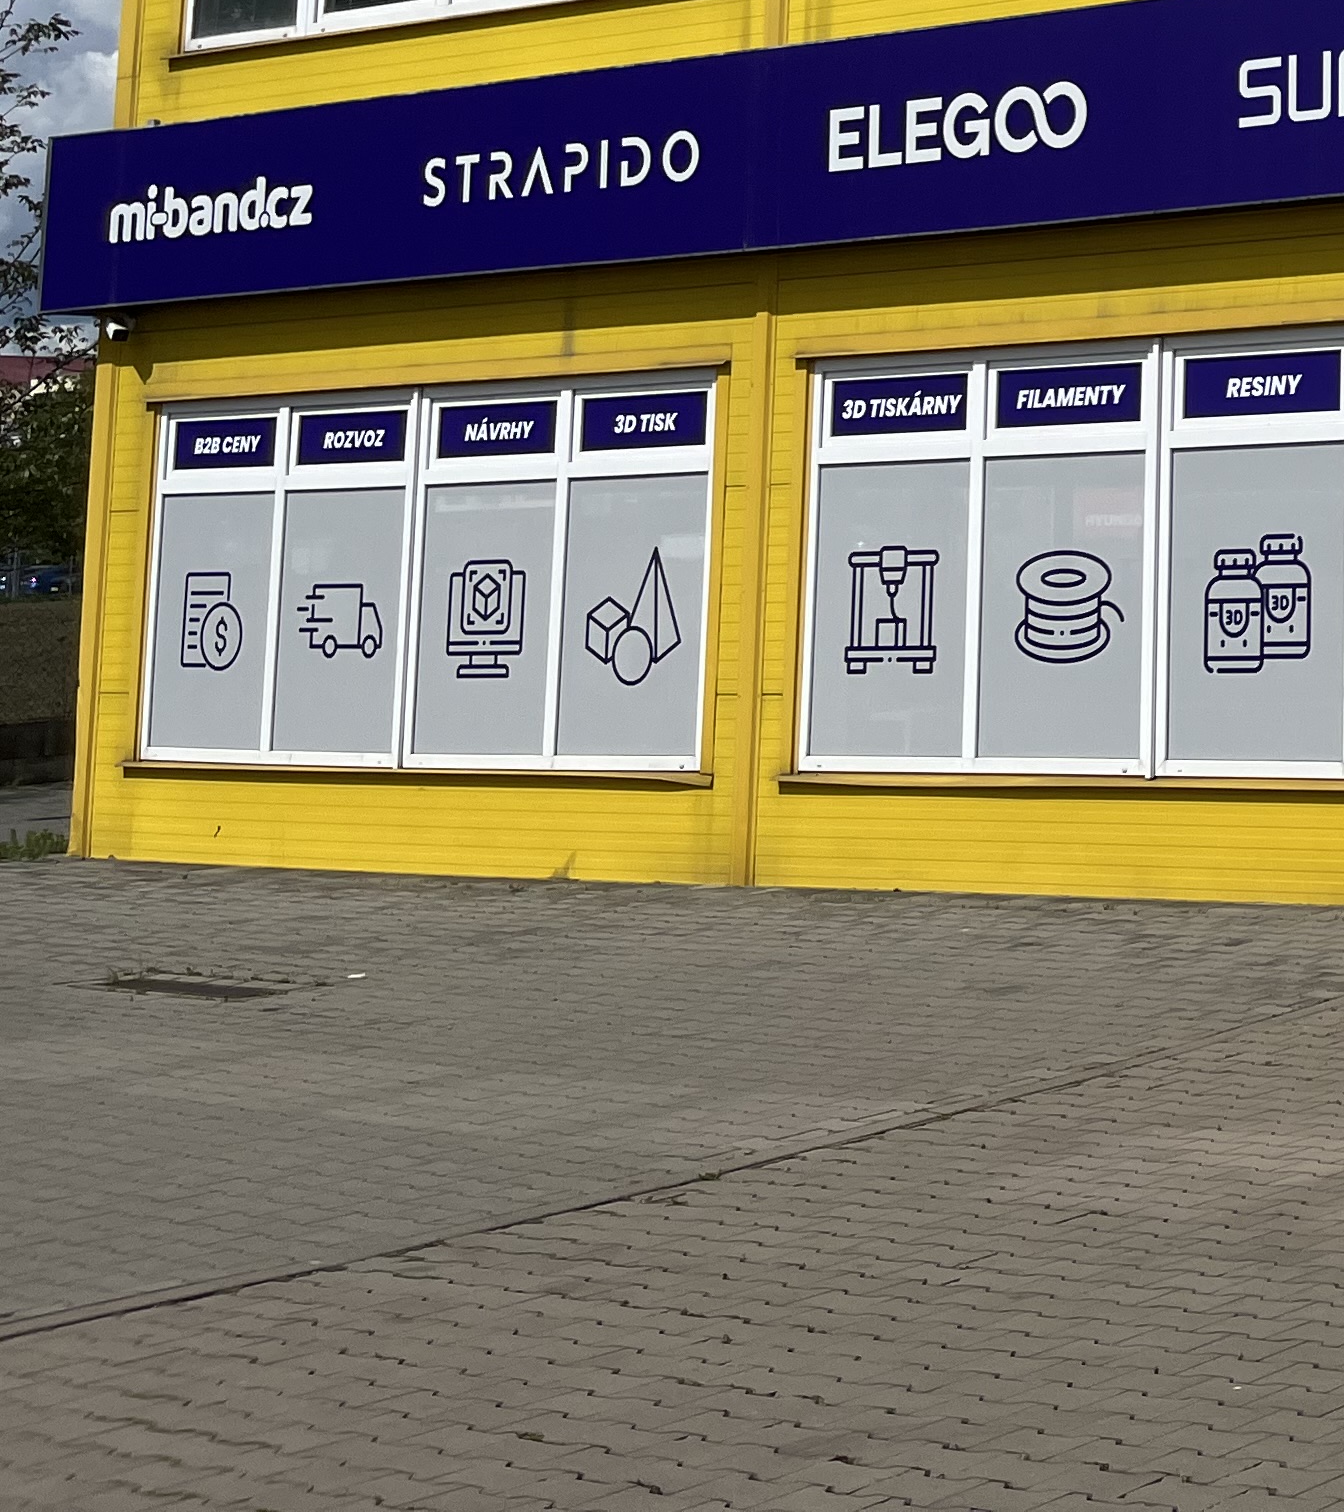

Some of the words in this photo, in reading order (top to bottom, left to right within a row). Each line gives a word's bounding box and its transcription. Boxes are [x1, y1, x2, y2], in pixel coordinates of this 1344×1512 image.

[829, 82, 1087, 172] ELEGOO
[424, 131, 699, 206] STRAPIDO
[1017, 385, 1126, 409] FILAMENTY
[1226, 374, 1302, 397] RESINY
[842, 400, 866, 419] 3D
[870, 391, 962, 417] TISKÁRNY
[465, 417, 534, 441] NÁVRHY
[614, 415, 636, 433] 3D
[640, 413, 678, 432] TISK
[194, 437, 220, 454] B2B
[223, 435, 261, 453] CENY
[323, 430, 385, 448] ROZVOZ
[1272, 595, 1289, 610] 3D
[1226, 610, 1243, 625] 3D
